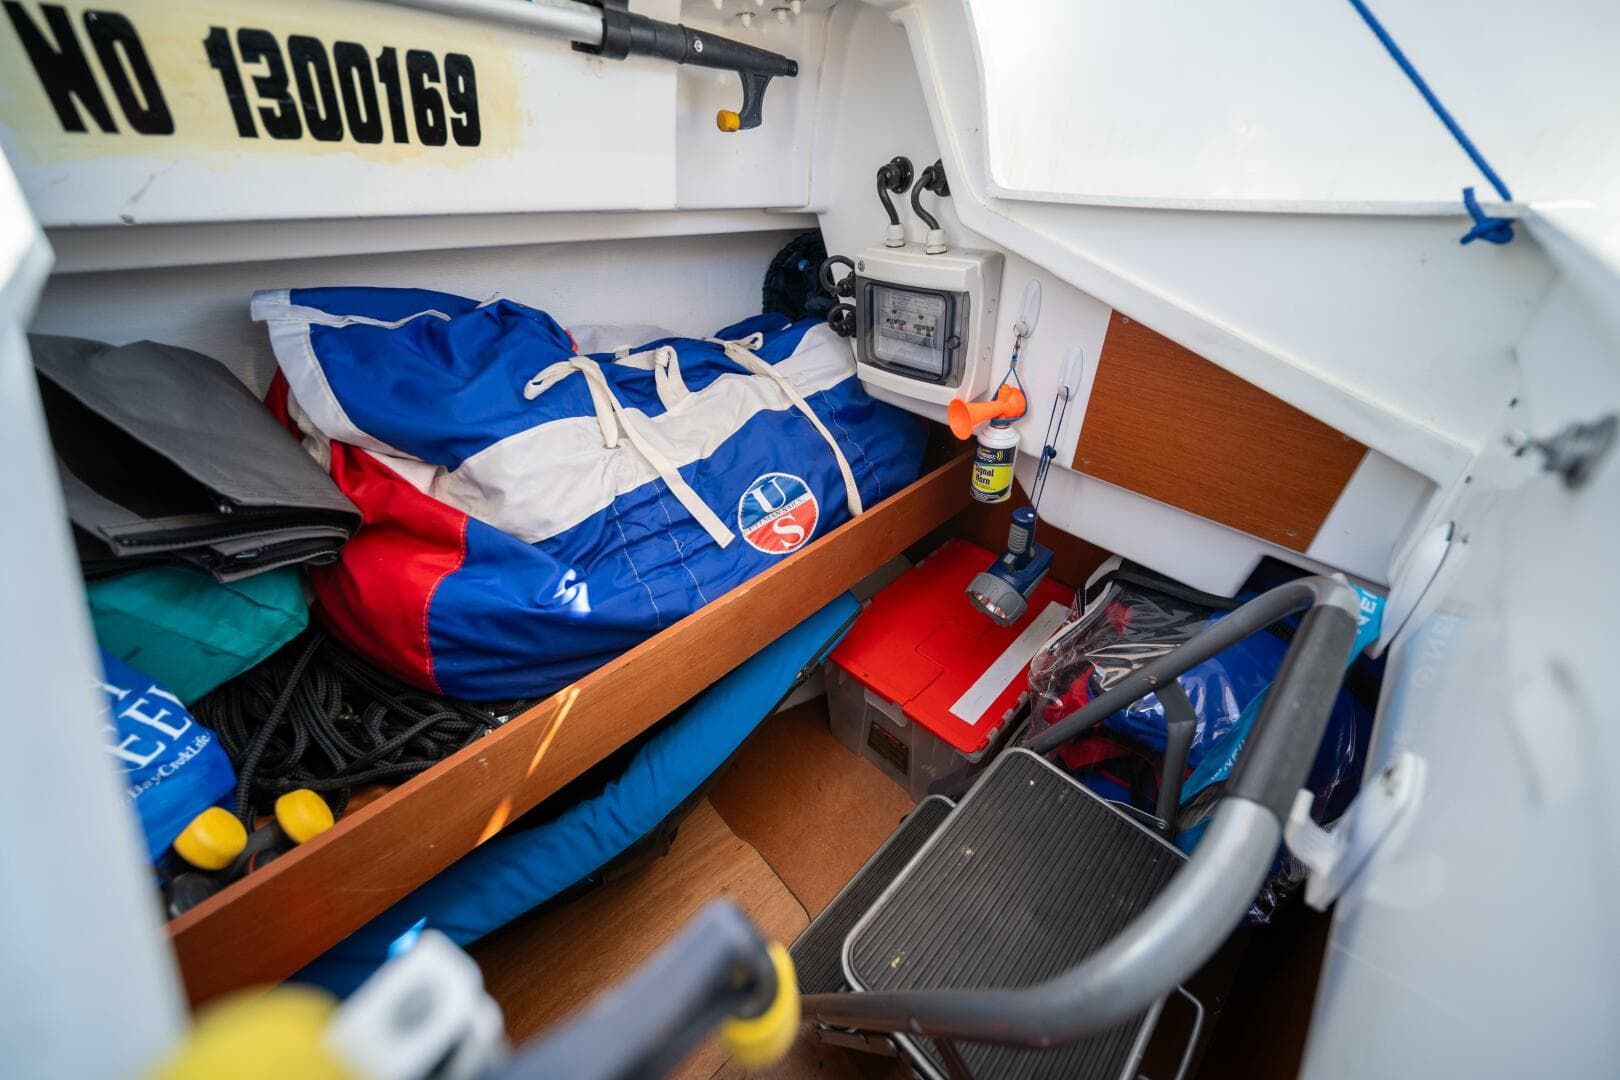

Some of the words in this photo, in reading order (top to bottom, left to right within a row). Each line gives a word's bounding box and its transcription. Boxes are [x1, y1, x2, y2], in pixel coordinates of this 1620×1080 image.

[0, 0, 175, 135] NO
[202, 26, 481, 147] 1300169
[975, 465, 994, 477] Signal
[975, 474, 991, 486] Horn
[747, 476, 786, 513] U
[773, 513, 804, 550] S
